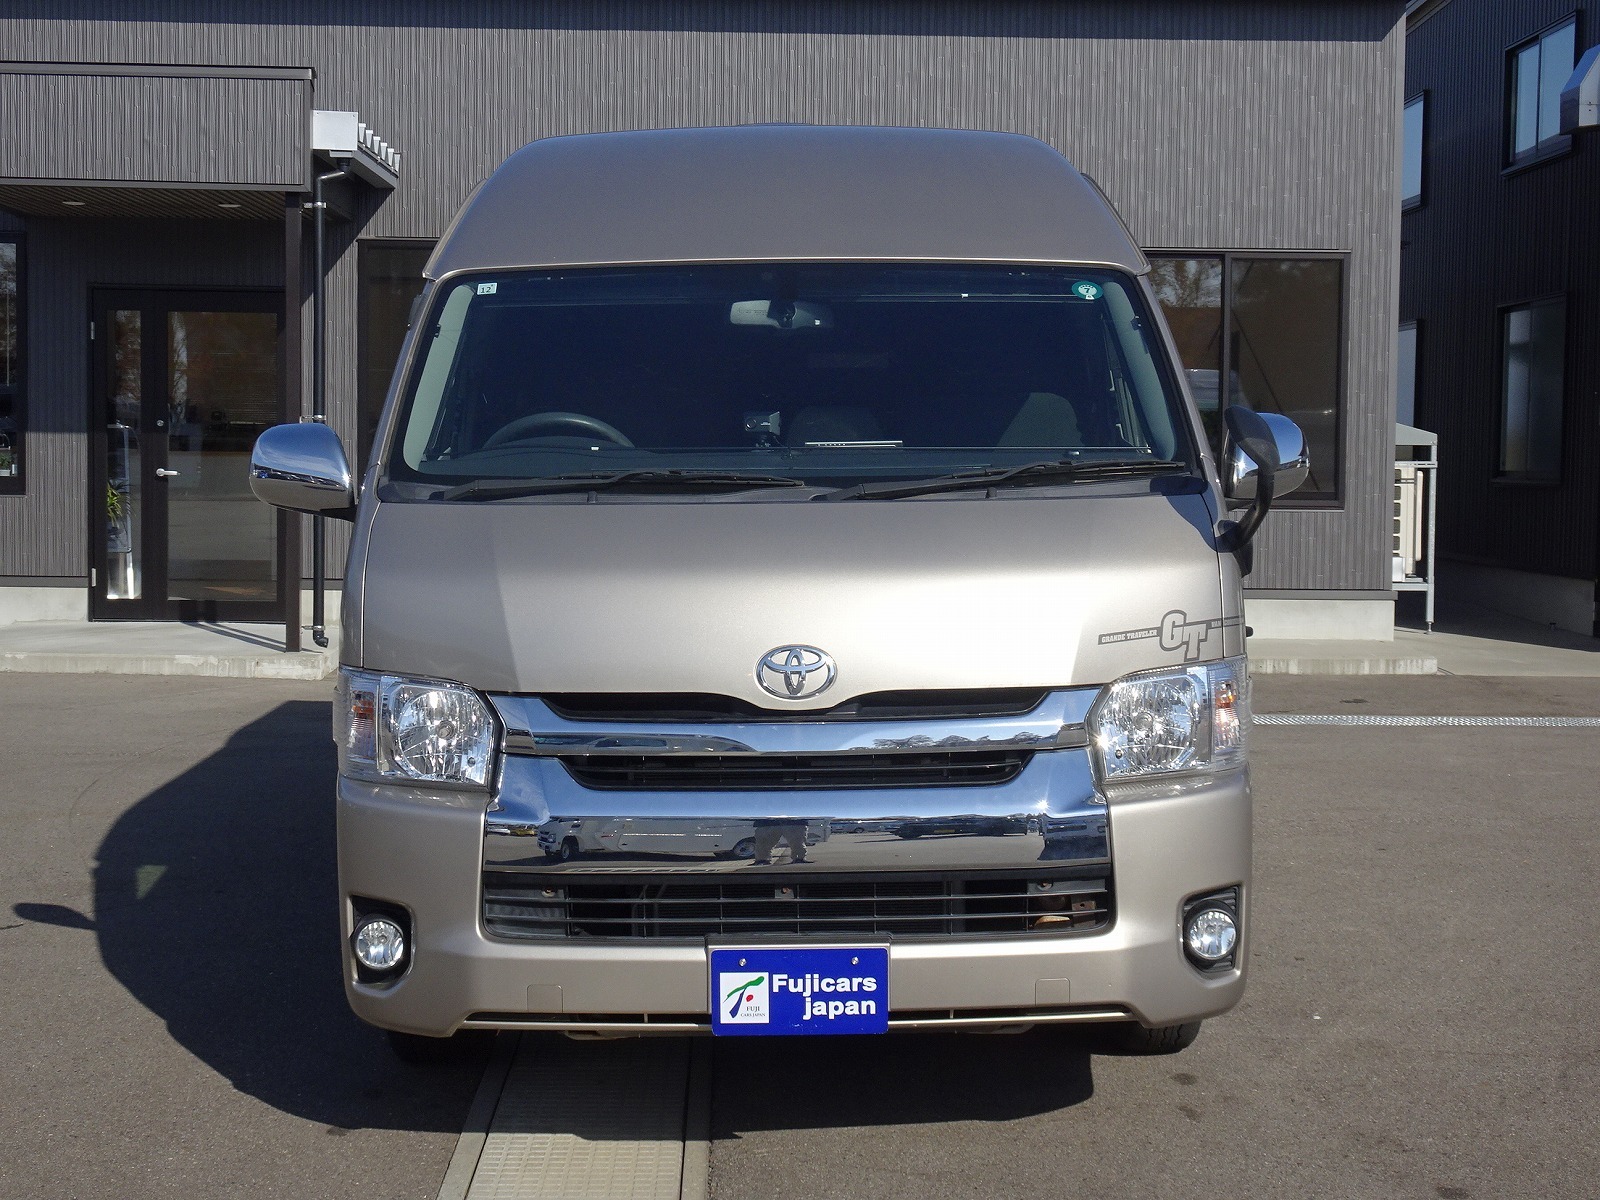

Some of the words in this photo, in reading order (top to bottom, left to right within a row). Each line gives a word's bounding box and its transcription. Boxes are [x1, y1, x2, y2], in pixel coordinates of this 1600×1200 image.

[1101, 633, 1126, 642] GRANDE
[1126, 629, 1158, 639] TRAVELER
[1159, 609, 1208, 662] GT
[772, 974, 877, 997] Fujicars
[803, 997, 876, 1020] japan
